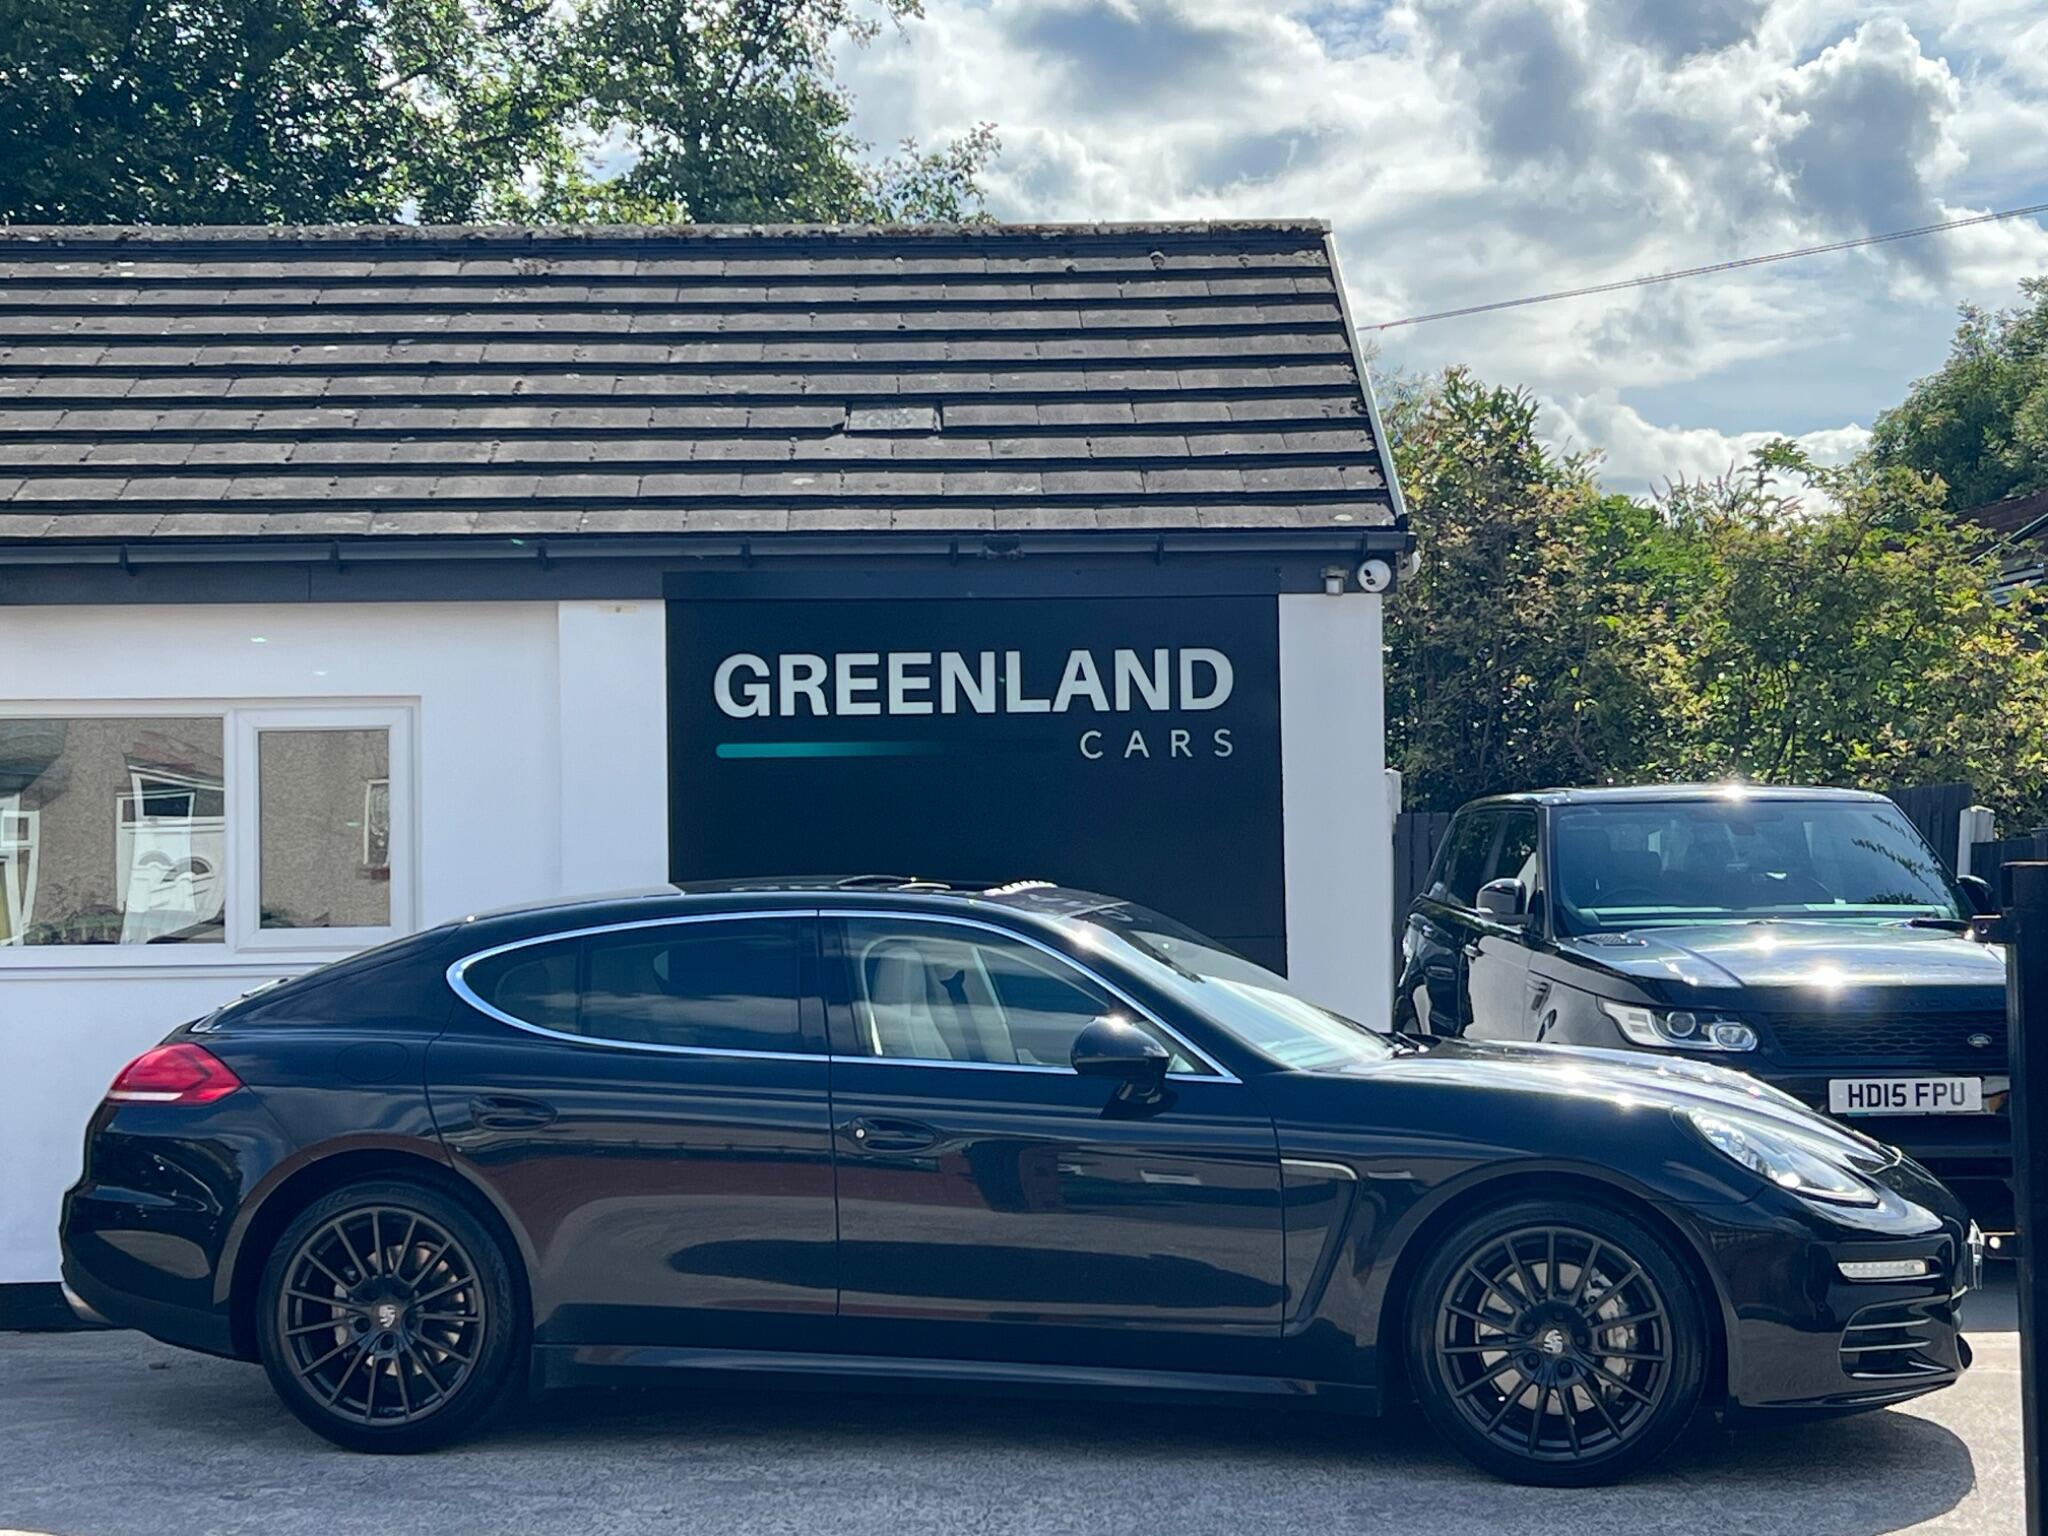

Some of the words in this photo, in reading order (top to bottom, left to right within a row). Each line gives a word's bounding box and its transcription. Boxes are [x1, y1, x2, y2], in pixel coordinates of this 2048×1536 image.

[713, 648, 1234, 718] GREENLAND
[1079, 729, 1234, 759] CARS
[1848, 1083, 1907, 1108] HD15
[1915, 1082, 1965, 1106] FPU
